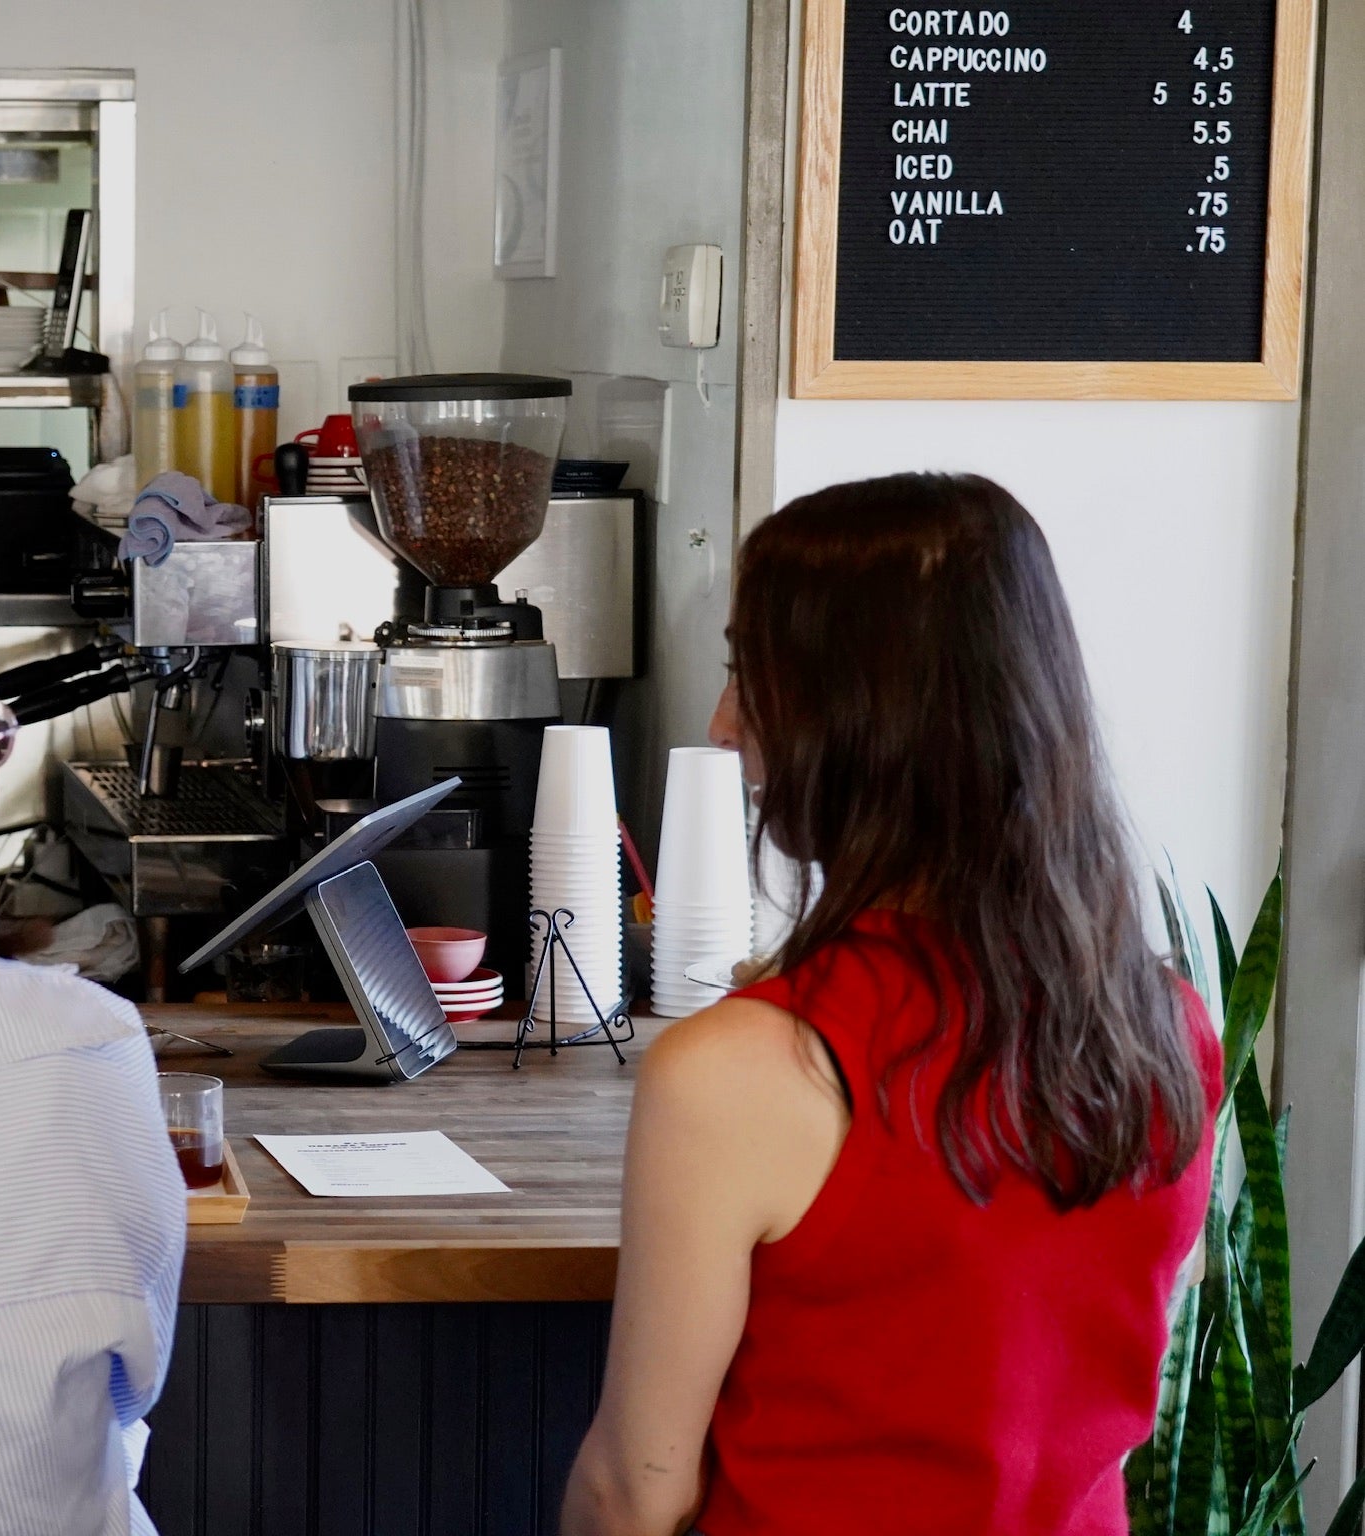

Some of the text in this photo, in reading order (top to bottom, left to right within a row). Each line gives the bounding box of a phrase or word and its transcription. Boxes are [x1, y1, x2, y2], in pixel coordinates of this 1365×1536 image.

[889, 8, 1193, 36] CORTADO 4
[890, 45, 1234, 73] CAPPUCCINO 4.5
[894, 81, 1233, 108] LATTE 5 5.5
[891, 118, 1232, 145] CHAI 5.5
[895, 154, 1230, 184] ICED .5
[890, 190, 1229, 217] VANILLA .75
[888, 218, 1226, 253] OAT .75
